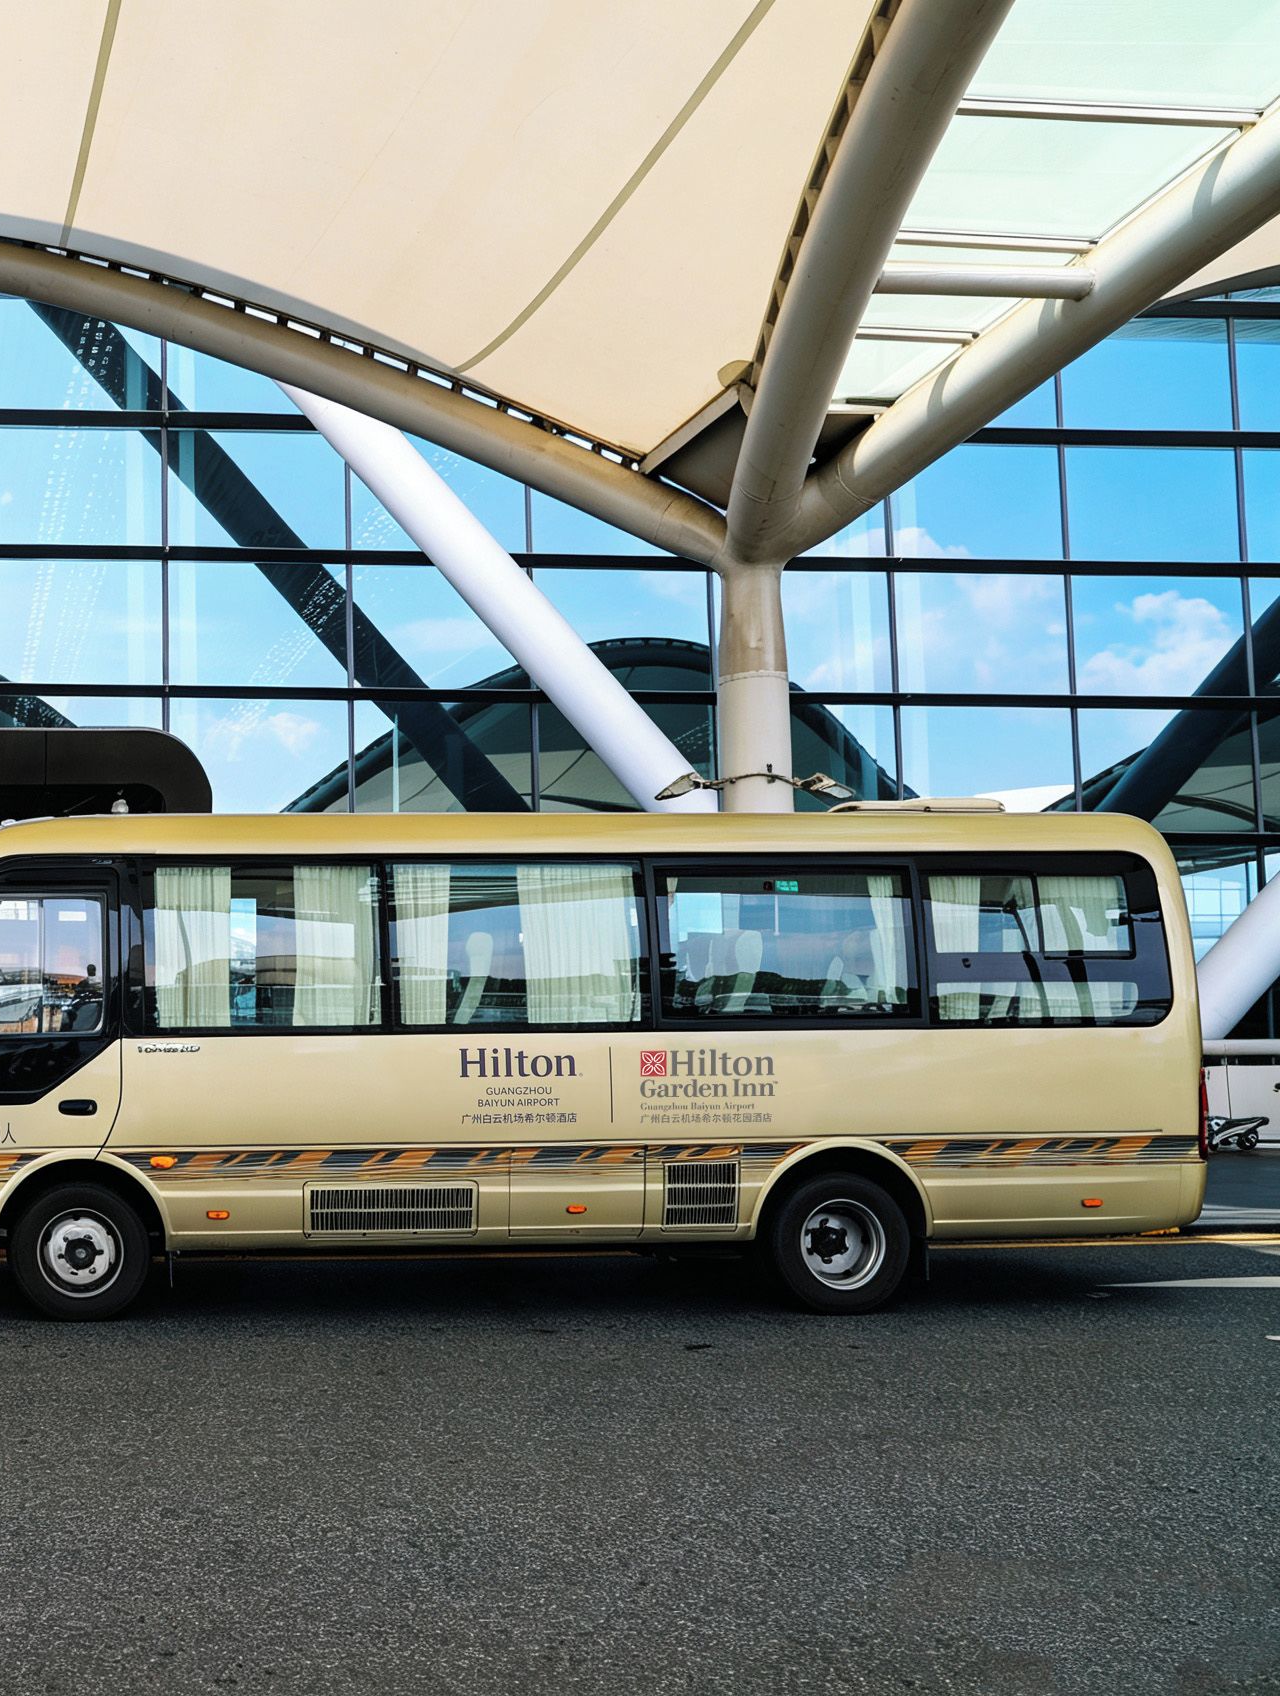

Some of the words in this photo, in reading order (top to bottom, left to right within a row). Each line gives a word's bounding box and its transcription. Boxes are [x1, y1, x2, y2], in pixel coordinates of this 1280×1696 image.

[459, 1047, 578, 1078] Hilton
[670, 1049, 775, 1077] Hilton
[485, 1086, 553, 1096] GUANGZHOU
[639, 1078, 728, 1099] Garden
[732, 1078, 776, 1097] Inn
[477, 1099, 515, 1108] BAIYUN
[517, 1097, 561, 1107] AIRPORT
[640, 1102, 688, 1111] Guangzhou
[690, 1102, 721, 1112] Baiyun
[723, 1102, 756, 1112] Airport
[461, 1112, 577, 1125] 广州白云机场希尔顿酒店
[639, 1112, 773, 1124] 广州白云机场希尔顿花园酒店
